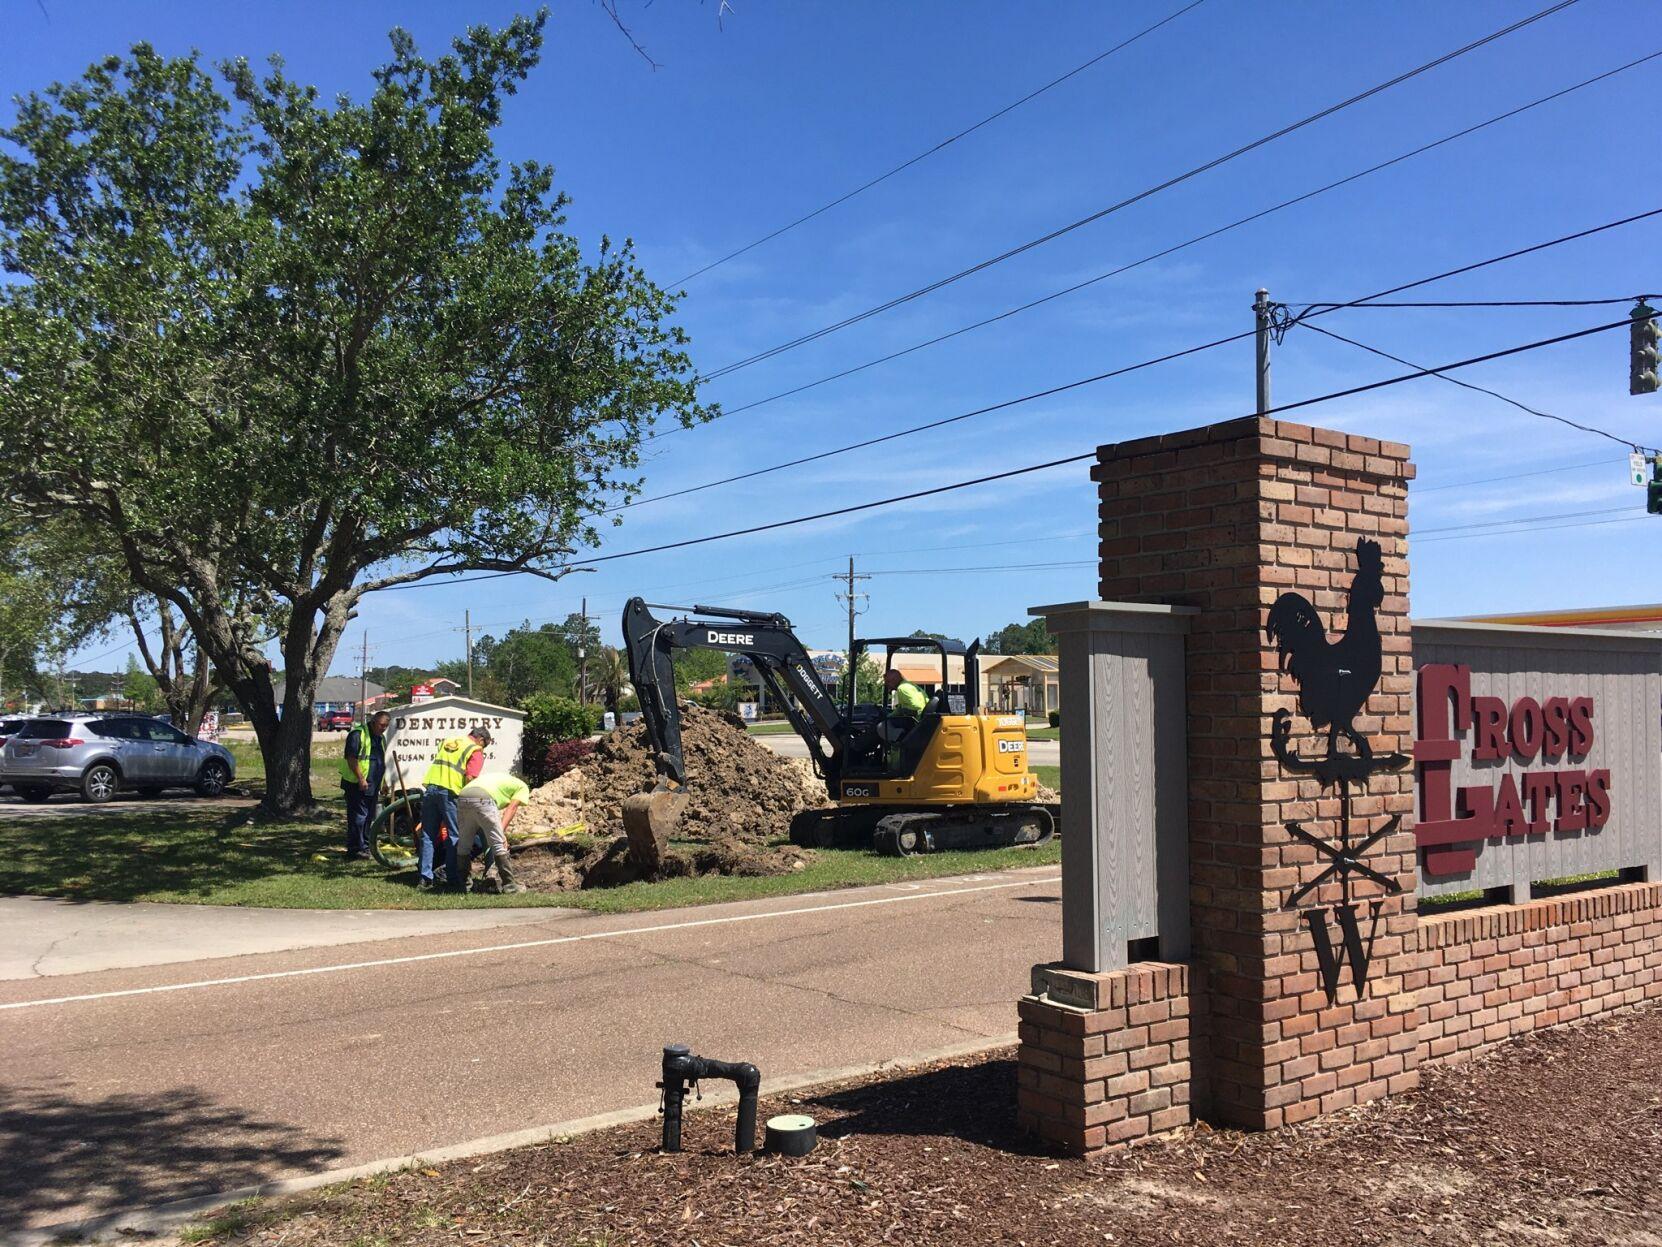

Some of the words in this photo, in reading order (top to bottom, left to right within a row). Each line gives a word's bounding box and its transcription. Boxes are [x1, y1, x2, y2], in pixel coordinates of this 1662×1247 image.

[708, 631, 754, 645] DEERE
[796, 664, 823, 699] DOGGETT
[396, 718, 504, 730] DENTISTRY
[397, 738, 429, 747] RONNIE
[846, 787, 869, 797] 60G
